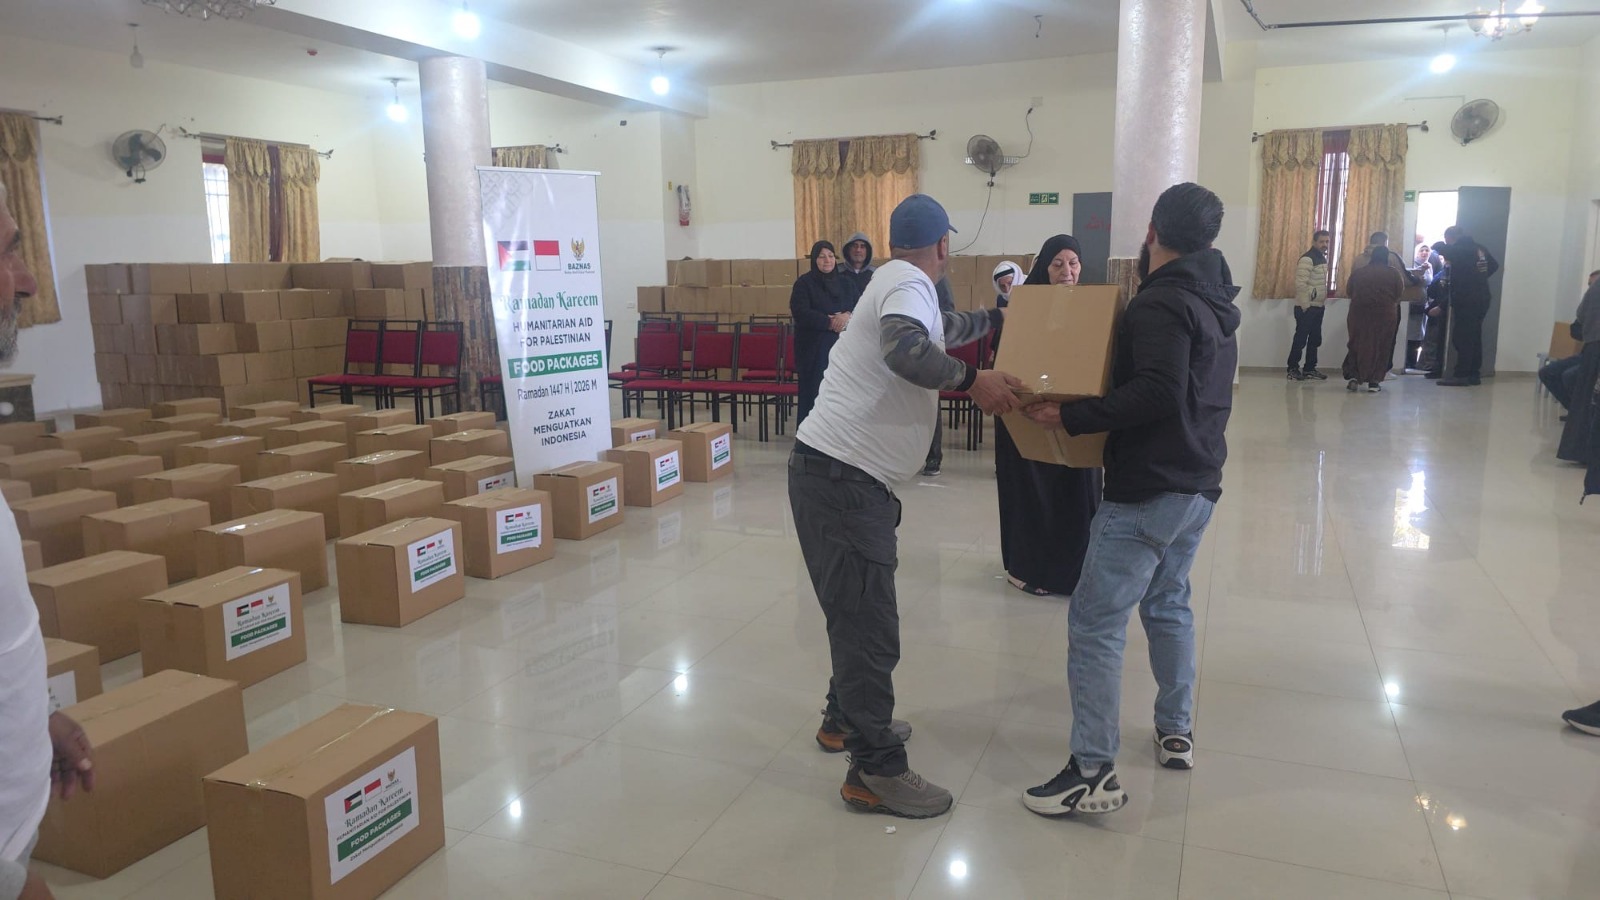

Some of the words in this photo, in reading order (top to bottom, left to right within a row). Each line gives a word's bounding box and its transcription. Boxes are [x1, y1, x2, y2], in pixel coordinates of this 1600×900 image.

[556, 291, 598, 310] Kareem
[513, 318, 576, 332] HUMANITARIAN
[578, 317, 593, 327] AID
[520, 336, 538, 348] FOR
[540, 332, 591, 346] PALESTINIAN
[513, 359, 545, 375] FOOD
[546, 354, 599, 371] PACKAGES
[517, 385, 549, 400] Ramadan
[549, 383, 563, 396] 1447
[564, 382, 570, 394] H
[574, 380, 590, 392] 2026
[591, 379, 597, 391] M
[548, 407, 576, 420] ZAKAT
[533, 417, 592, 435] MENGUATKAN
[541, 430, 587, 446] INDONESIA
[240, 631, 254, 641] FOOD
[254, 623, 278, 636] PACKAGES
[344, 803, 378, 828] Ramadan
[378, 787, 404, 807] Kareem
[350, 831, 370, 848] FOOD
[369, 810, 402, 836] PACKAGES
